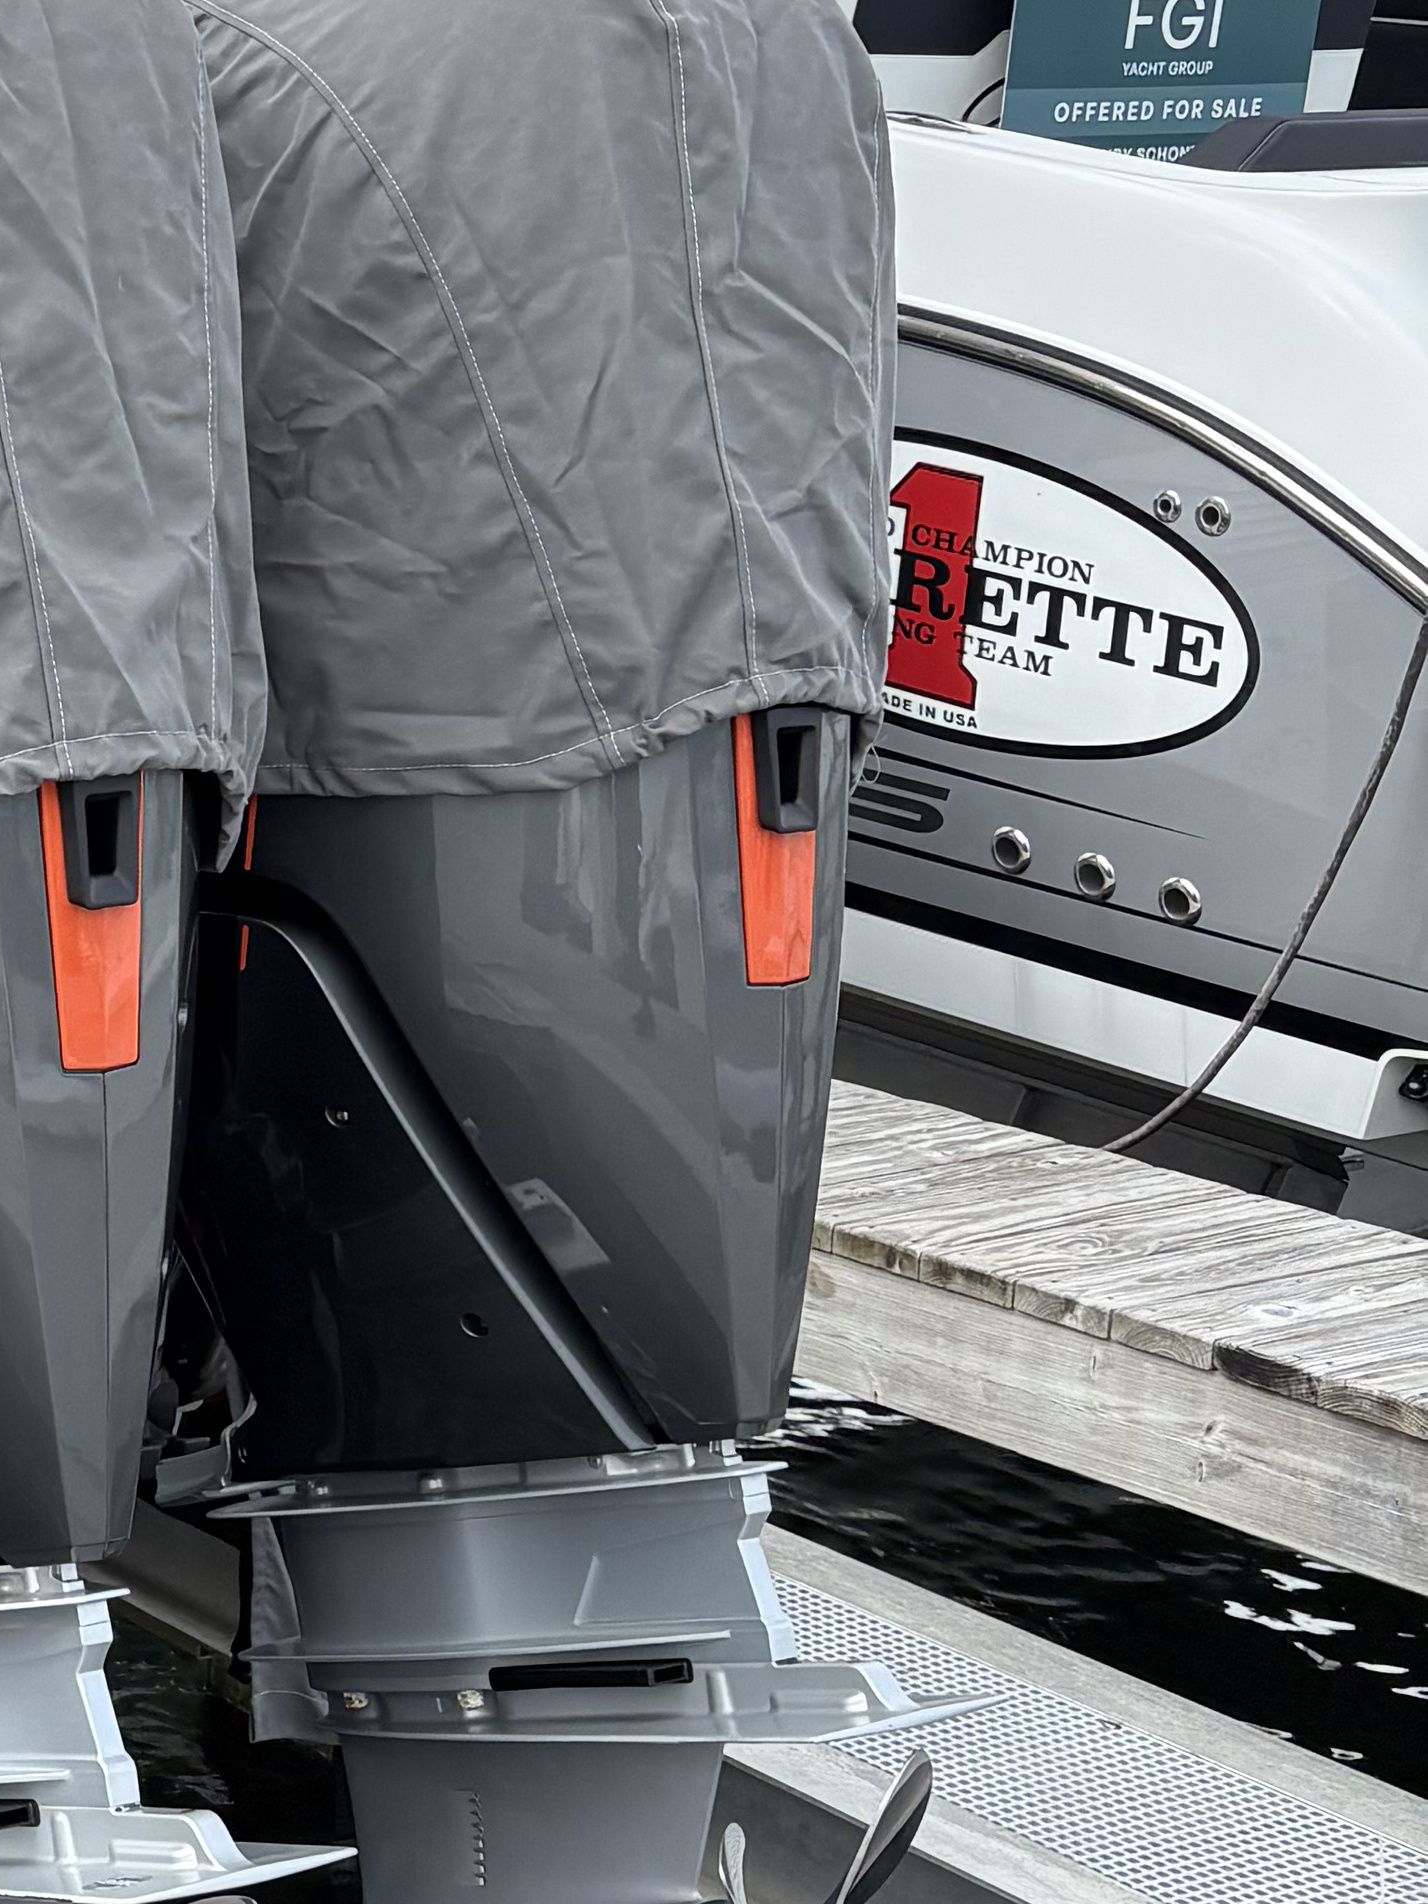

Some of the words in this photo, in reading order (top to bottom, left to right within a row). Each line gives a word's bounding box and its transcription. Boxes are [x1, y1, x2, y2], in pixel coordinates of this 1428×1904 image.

[1122, 61, 1166, 76] YACHT
[1168, 61, 1214, 75] GROUP
[1054, 101, 1154, 123] OFFERED
[1162, 99, 1204, 120] FOR
[1211, 97, 1263, 118] SALE
[911, 524, 1095, 585] CHAMPION
[890, 548, 1224, 687] RETTE
[953, 631, 1054, 676] TEAM
[919, 701, 936, 719] IN
[943, 709, 978, 729] USA
